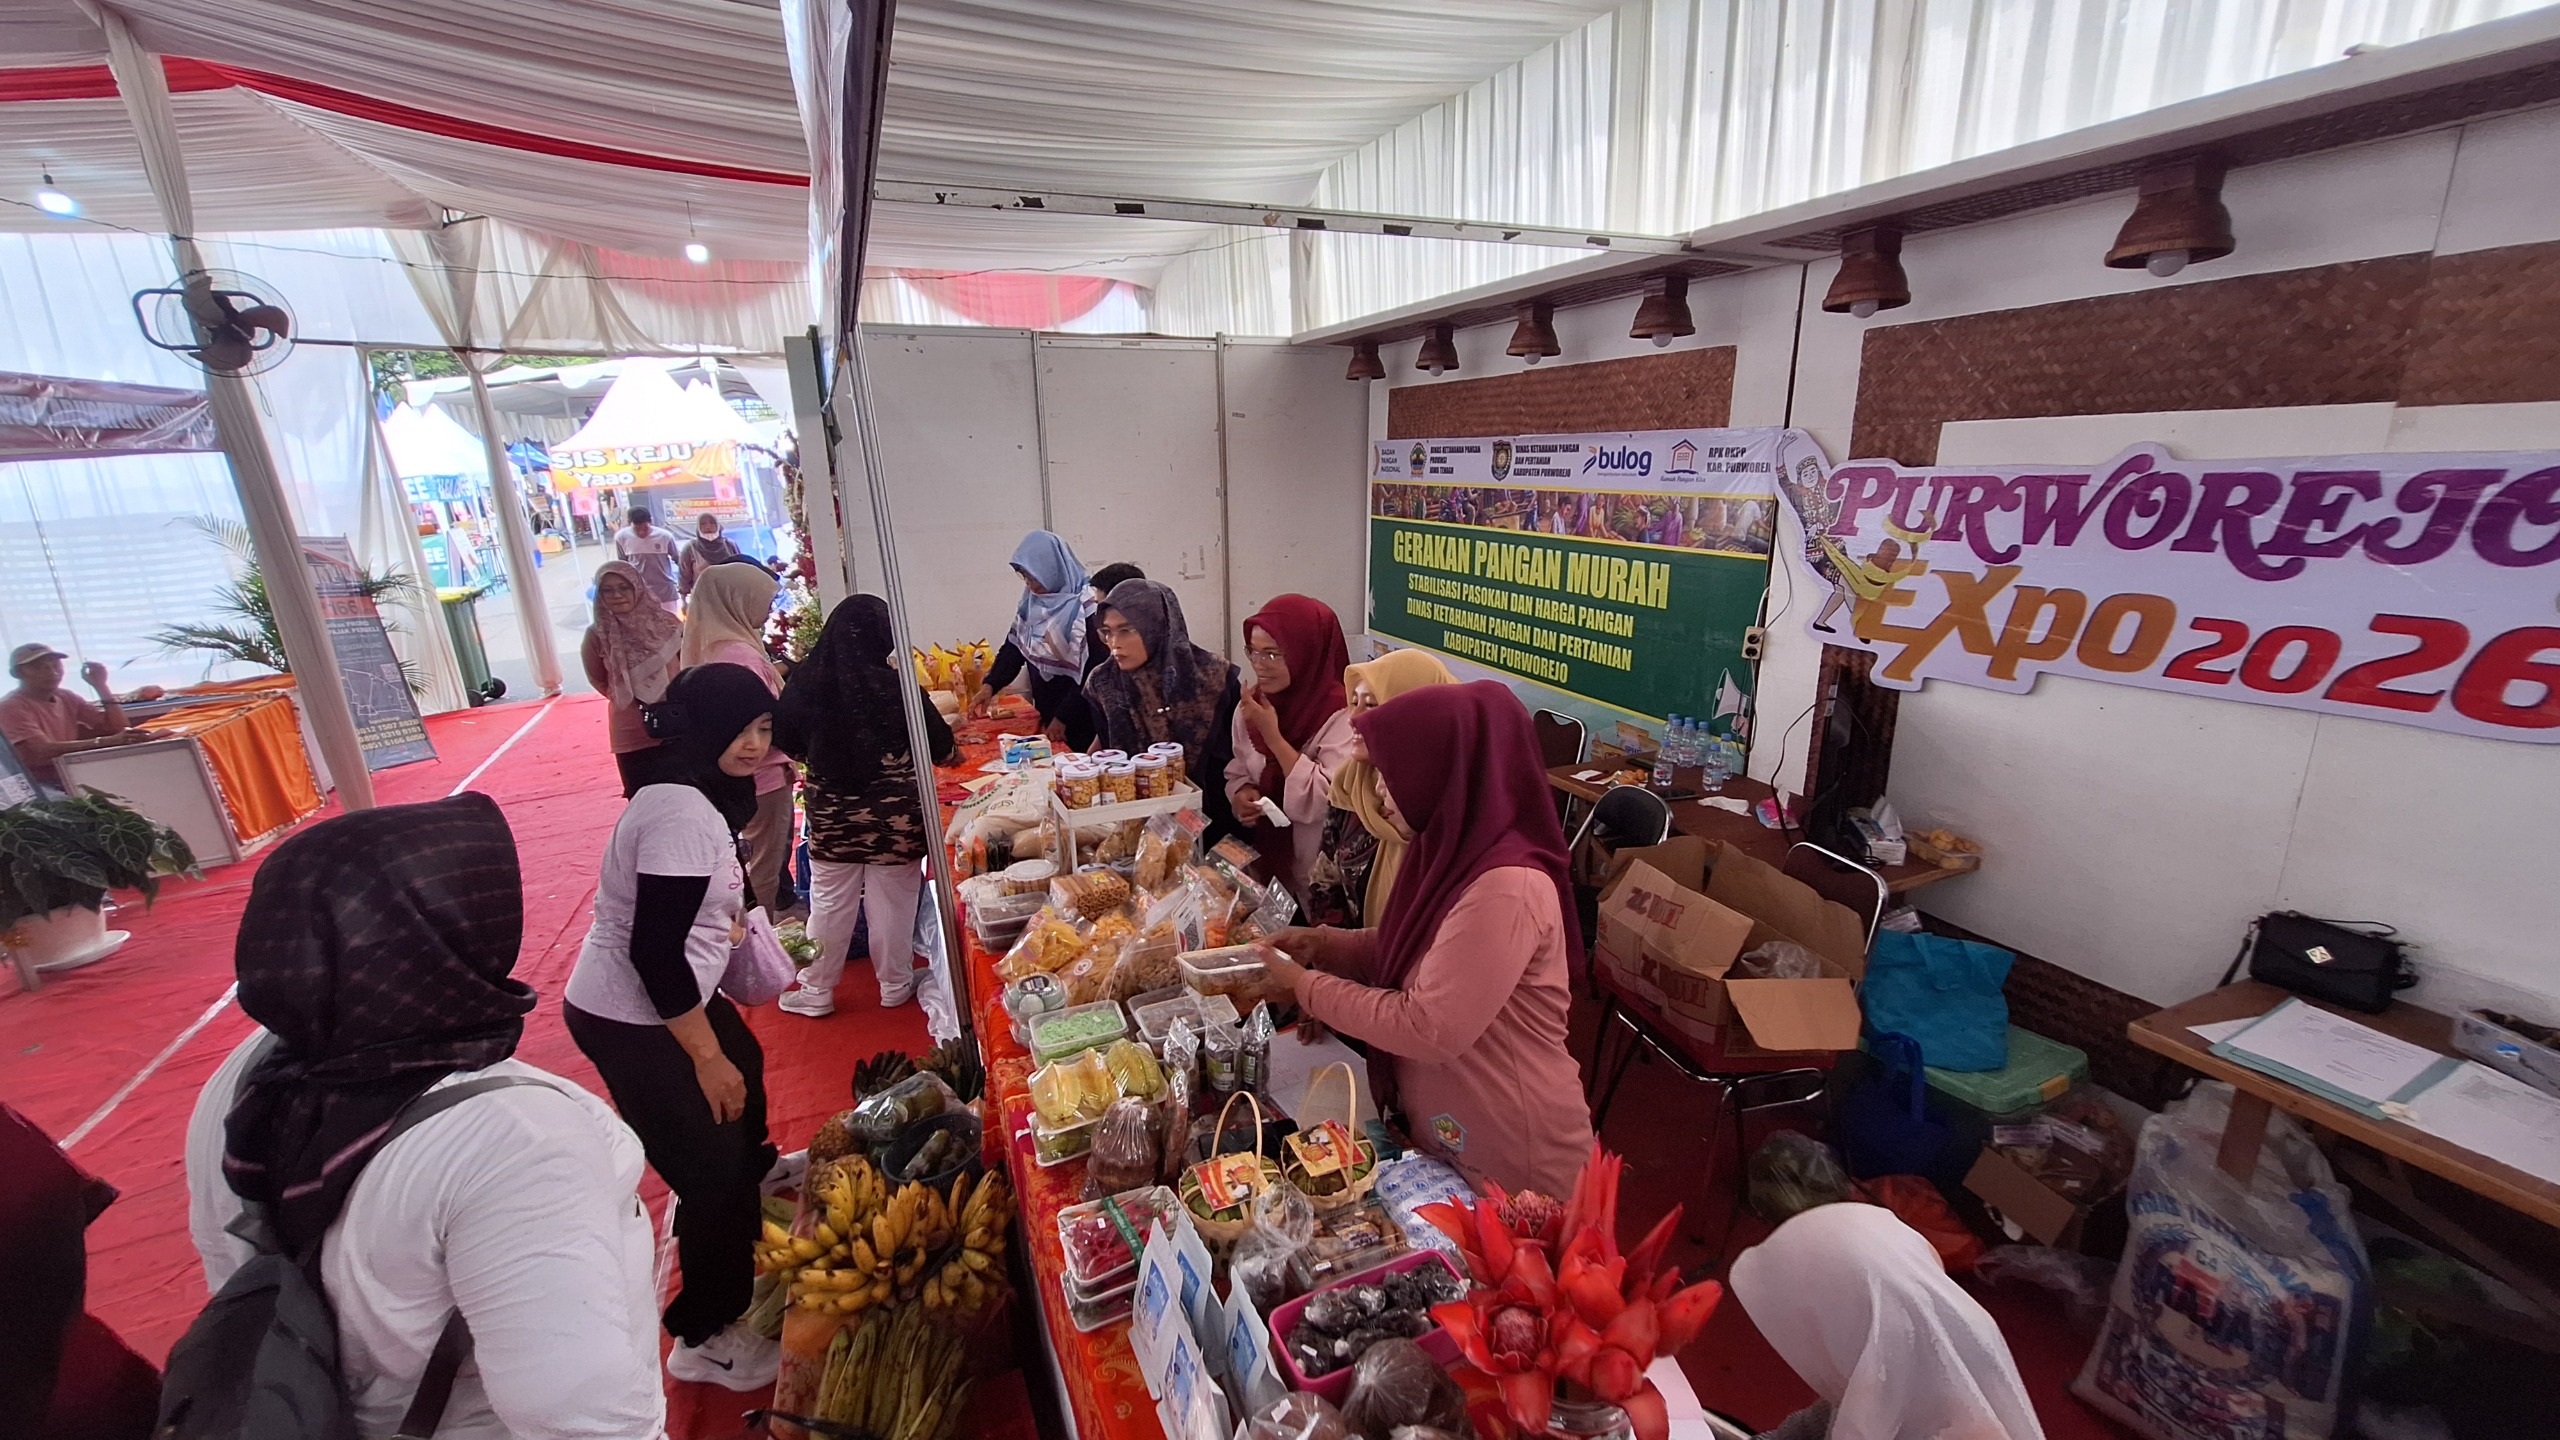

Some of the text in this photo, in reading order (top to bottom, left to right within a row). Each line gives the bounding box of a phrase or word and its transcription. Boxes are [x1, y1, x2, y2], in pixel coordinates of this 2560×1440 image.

[615, 443, 693, 465] KEJU
[1381, 448, 1396, 456] BADAN
[1515, 443, 1580, 454] DINAS KETAHANAN PANGAN
[1708, 447, 1746, 458] RPK DKPP
[1381, 466, 1401, 474] NASIONAL
[1515, 456, 1551, 466] DAN PERTANIAN
[1598, 445, 1653, 477] bulog
[1707, 462, 1724, 473] KAB.
[1513, 468, 1571, 478] KABUPATEN PURWOREJO
[1825, 453, 2560, 580] PURWOREJO
[1393, 530, 1671, 609] GERAKAN PANGAN MURAH
[1408, 572, 1634, 638] STABILISASI PASOKAN DAN HARGA PANGAN
[1406, 597, 1632, 672] DINAS KETAHANAN PANGAN DAN PERTANIAN
[1443, 630, 1569, 684] KABUPATEN PURWOREJO
[2163, 613, 2560, 729] 2026
